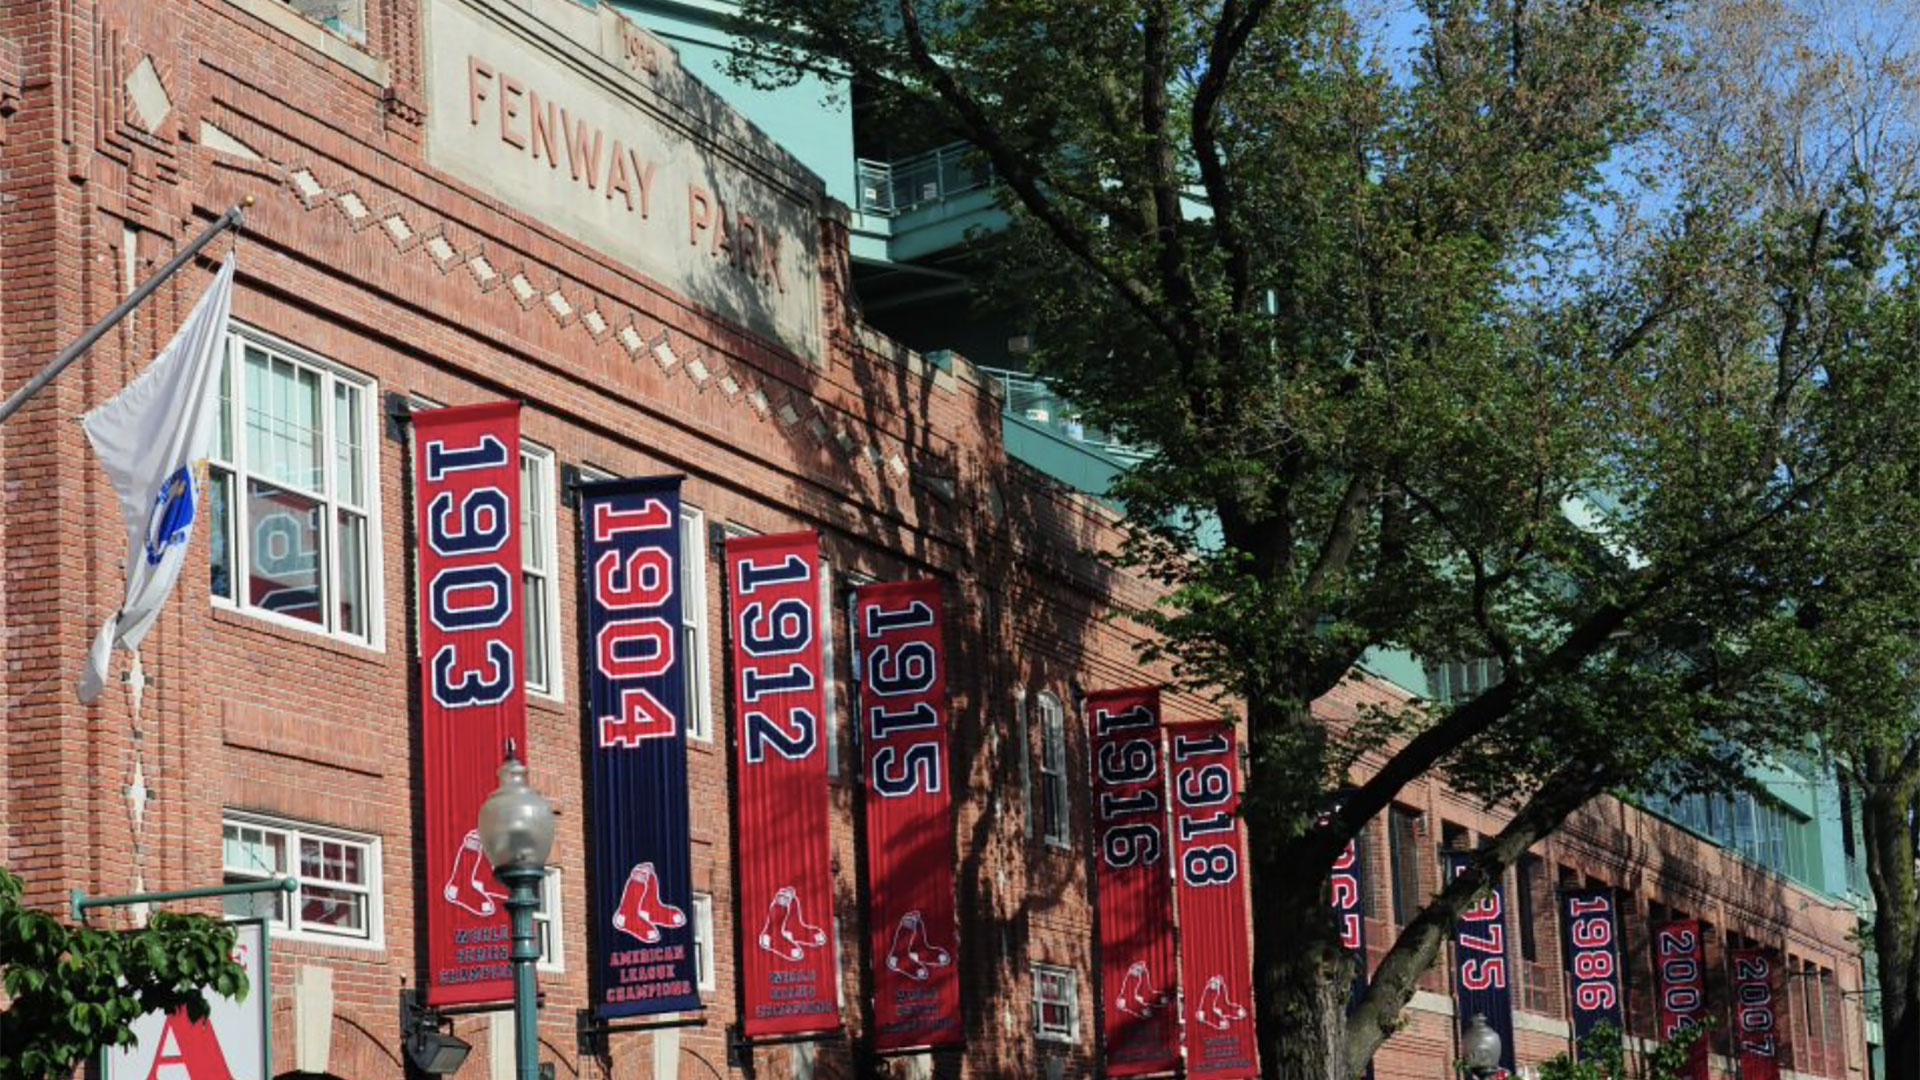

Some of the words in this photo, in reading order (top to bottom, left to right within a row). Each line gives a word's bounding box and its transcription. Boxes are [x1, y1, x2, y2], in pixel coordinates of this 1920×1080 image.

[468, 54, 656, 220] FENWAY
[689, 182, 786, 294] PARK
[426, 434, 515, 709] 1903
[594, 499, 677, 748] 1904
[738, 554, 817, 764] 1912
[866, 600, 941, 797] 1915
[1096, 705, 1161, 868] 1916
[1175, 733, 1238, 887] 1918
[606, 981, 693, 1004] CHAMPIONS
[610, 944, 686, 968] AMERICAN
[620, 964, 676, 984] LEAGUE
[1570, 896, 1617, 1010] 1986
[1736, 957, 1775, 1057] 2007
